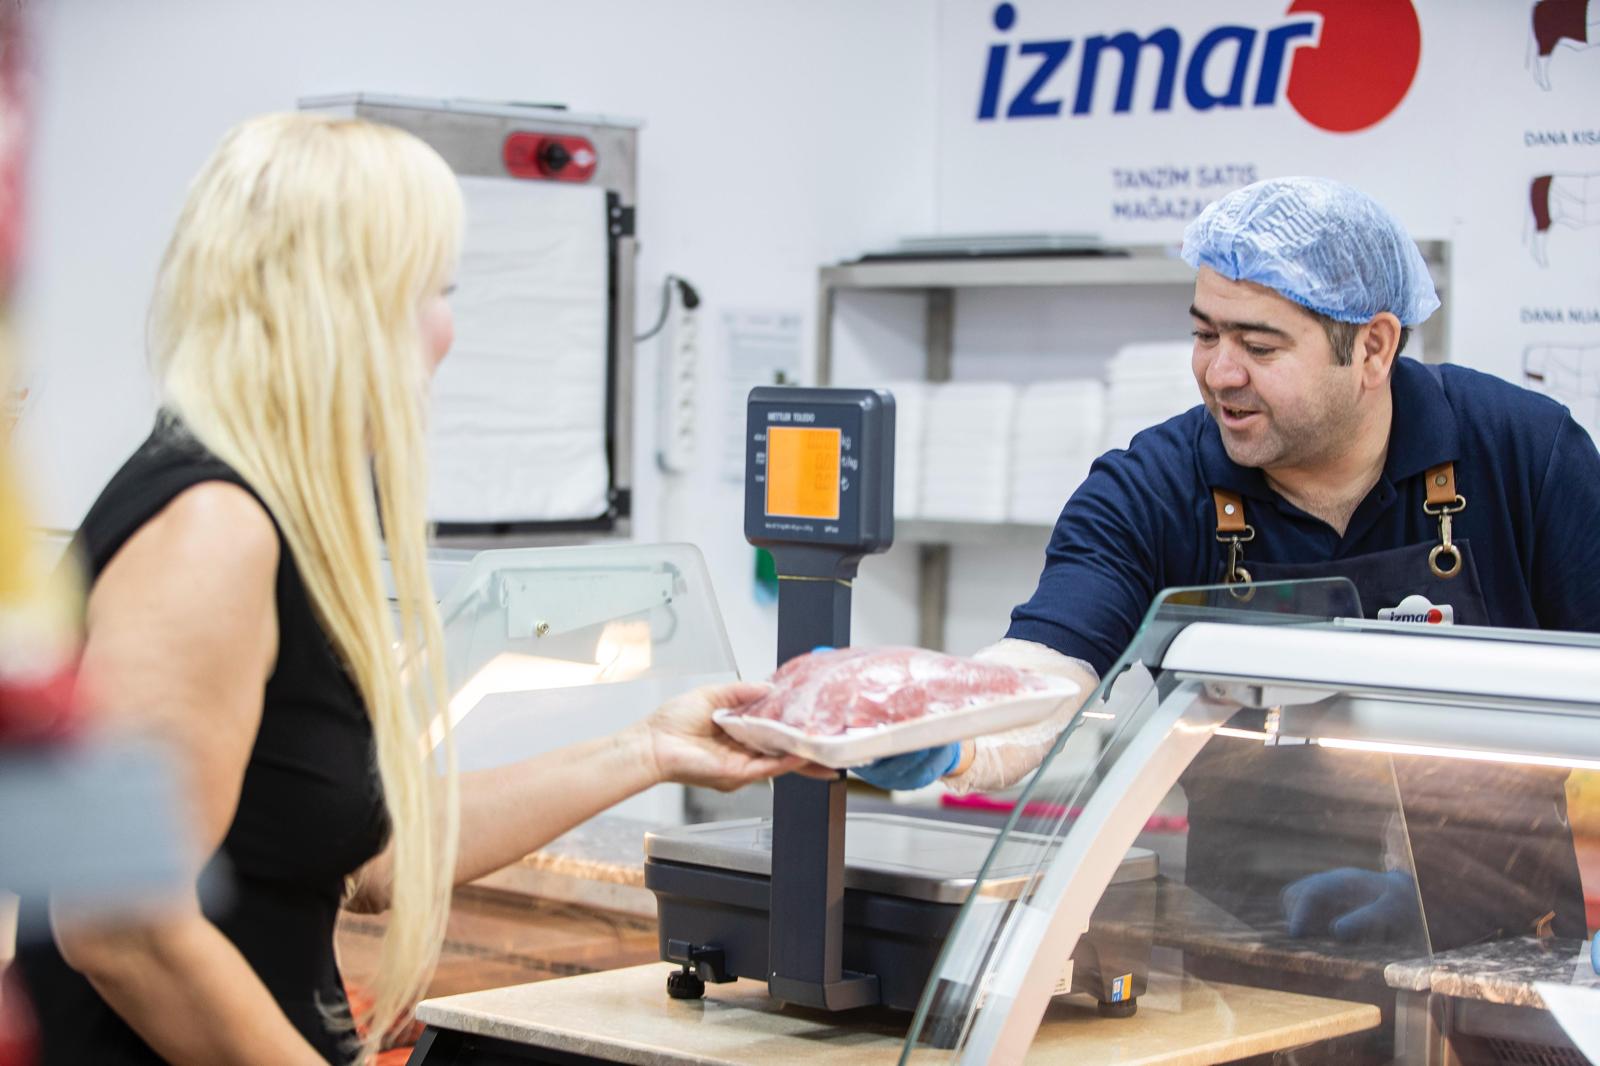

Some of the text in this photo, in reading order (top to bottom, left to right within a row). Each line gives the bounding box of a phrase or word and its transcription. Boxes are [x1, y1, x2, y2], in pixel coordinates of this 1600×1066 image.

[976, 2, 1315, 120] izmar
[1524, 130, 1568, 147] DANA
[1520, 306, 1564, 323] DANA
[1390, 611, 1430, 623] izmar
